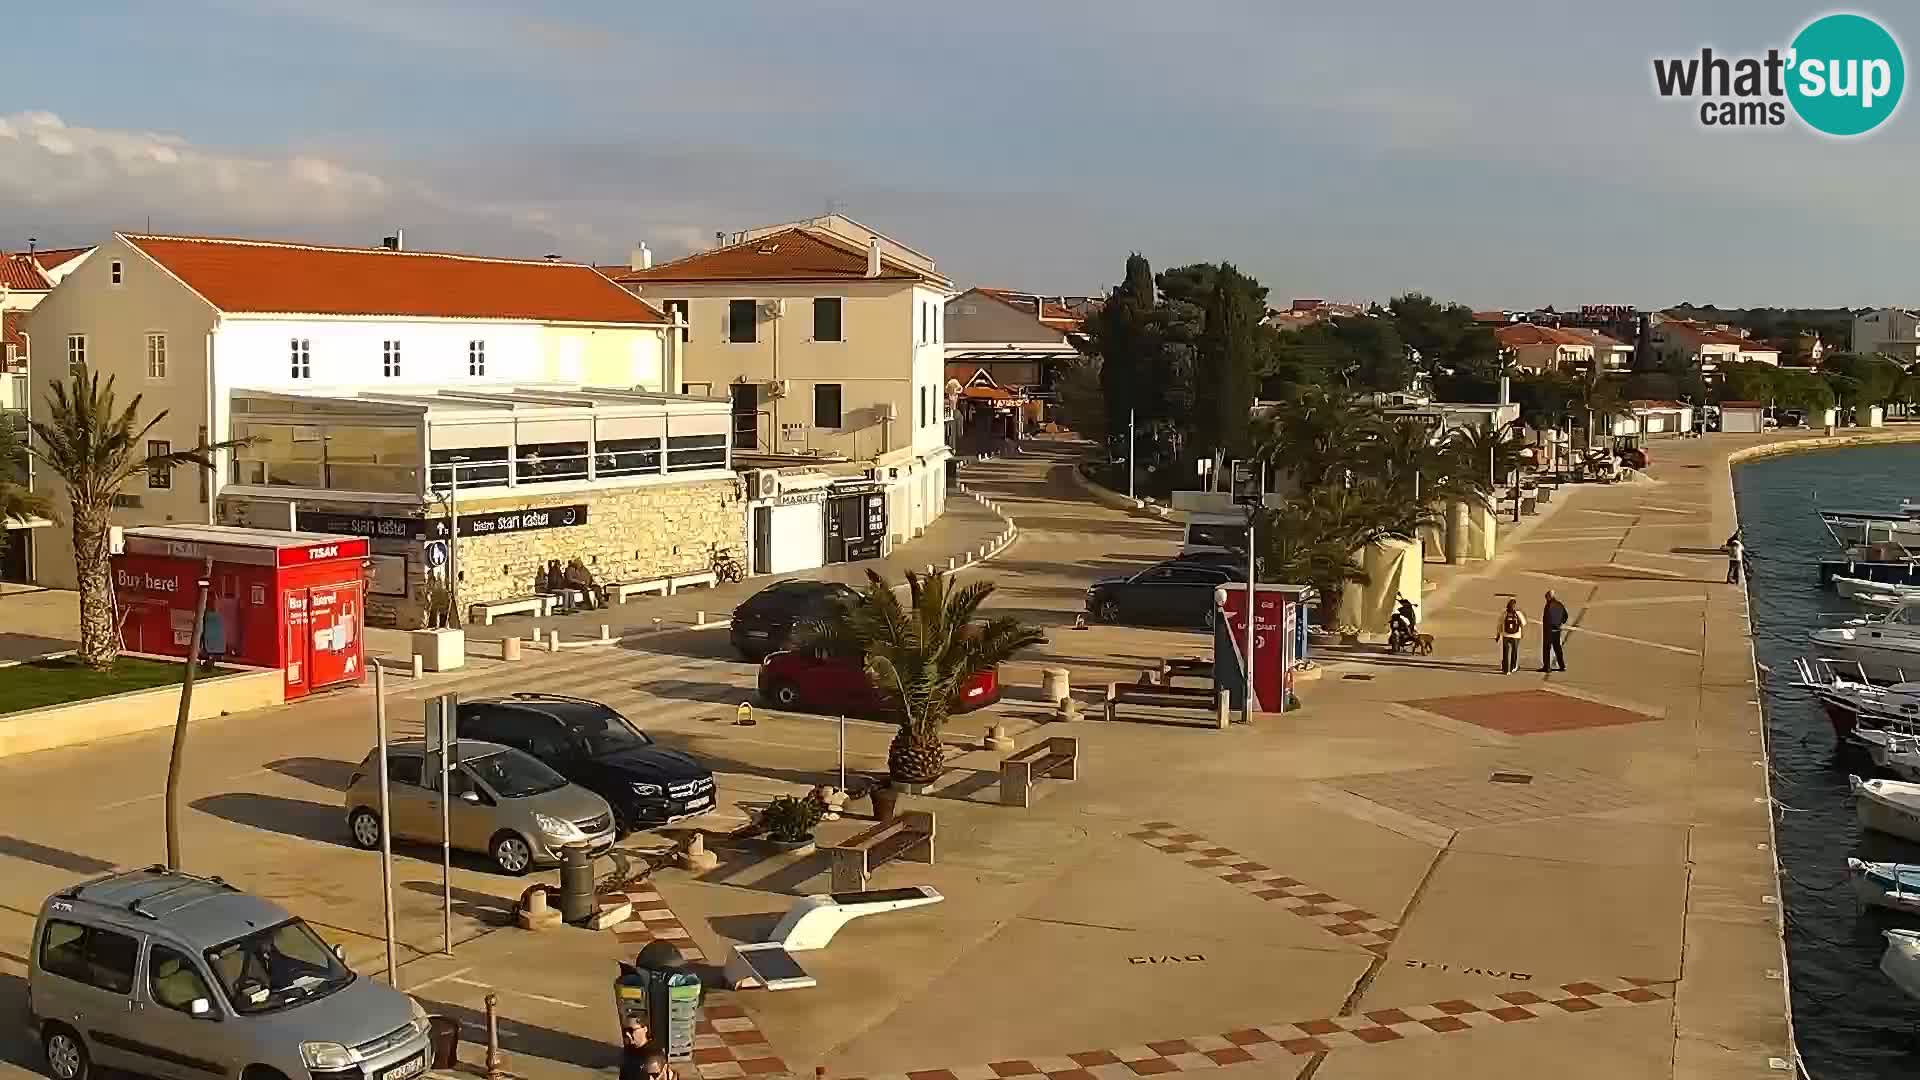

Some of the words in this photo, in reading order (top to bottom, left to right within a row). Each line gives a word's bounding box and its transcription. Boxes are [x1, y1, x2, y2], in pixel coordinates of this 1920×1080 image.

[309, 545, 339, 560] TISAK
[118, 569, 142, 591] Buy
[145, 571, 179, 592] here!
[289, 596, 308, 612] Buy
